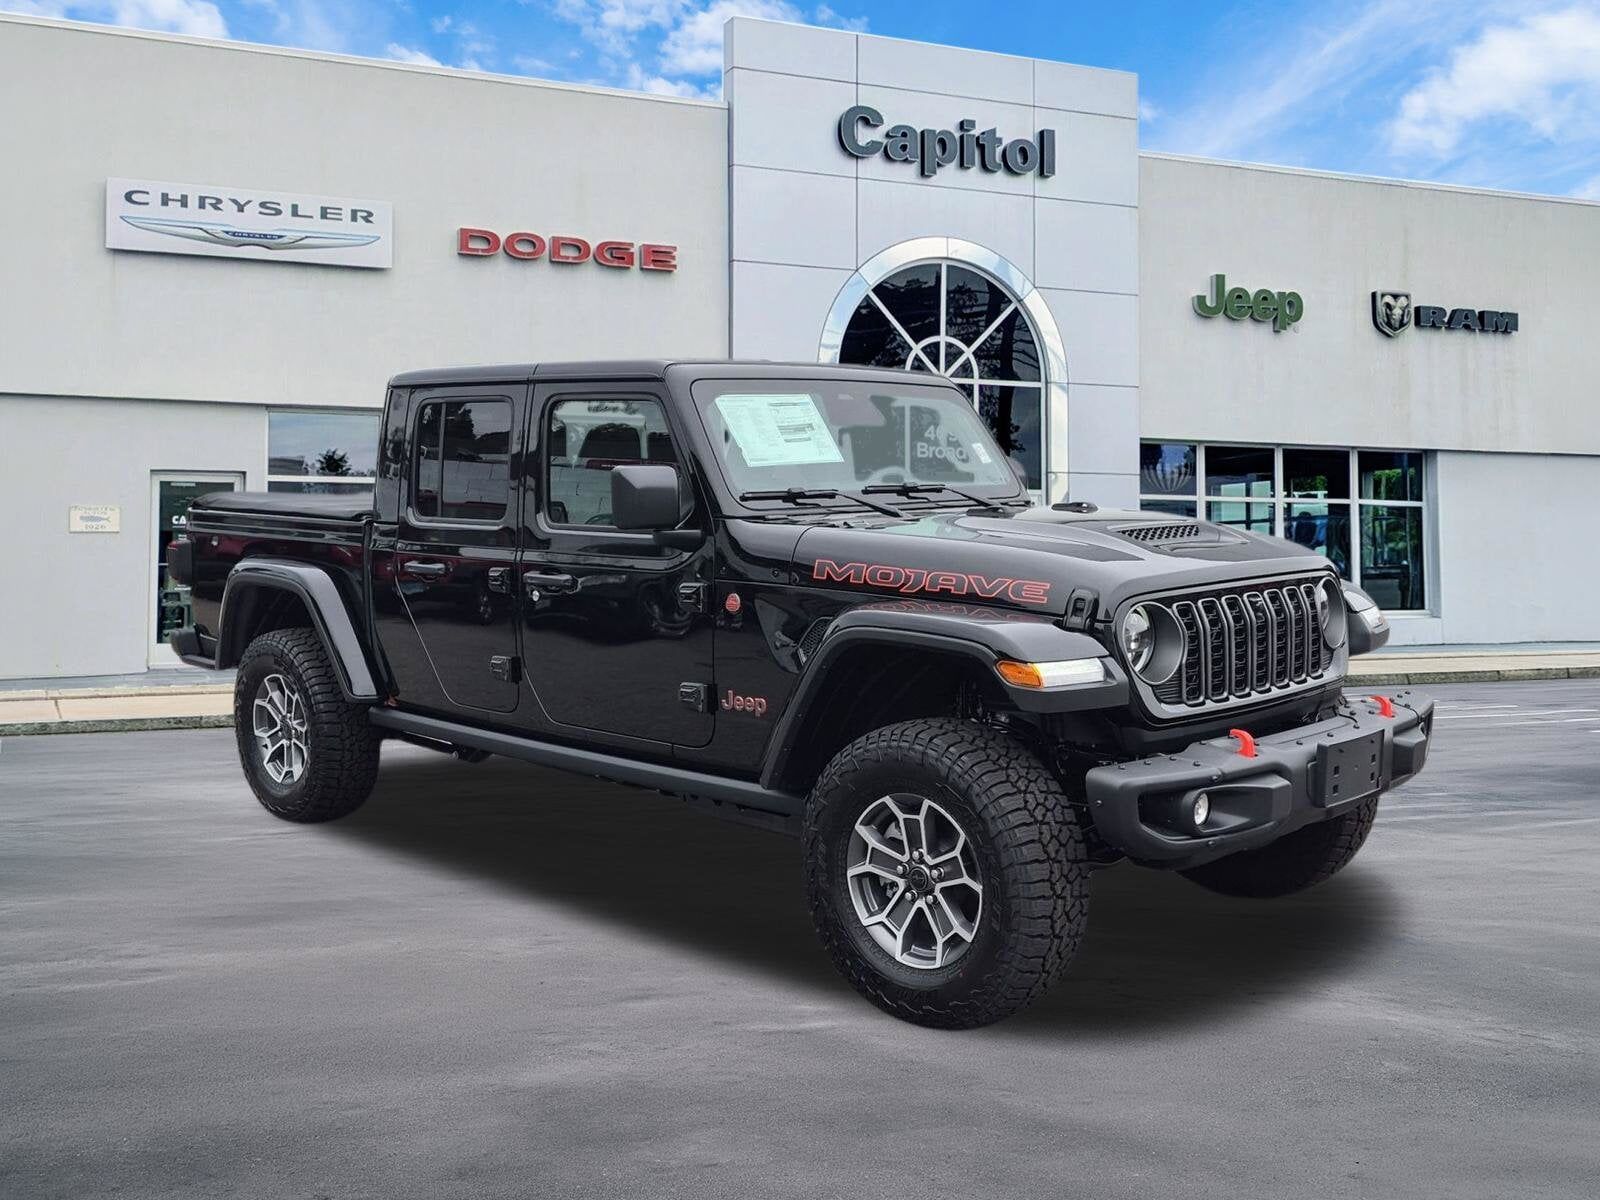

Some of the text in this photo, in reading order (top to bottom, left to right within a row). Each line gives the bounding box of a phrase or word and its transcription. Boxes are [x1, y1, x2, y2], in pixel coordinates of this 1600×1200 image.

[838, 105, 1056, 177] Capitol
[123, 189, 375, 224] CHRYSLER
[457, 227, 678, 272] DODGE
[1192, 273, 1304, 333] Jeep
[1414, 305, 1519, 333] RAM
[812, 559, 1051, 604] MOJAVE
[721, 689, 768, 717] Jeep
